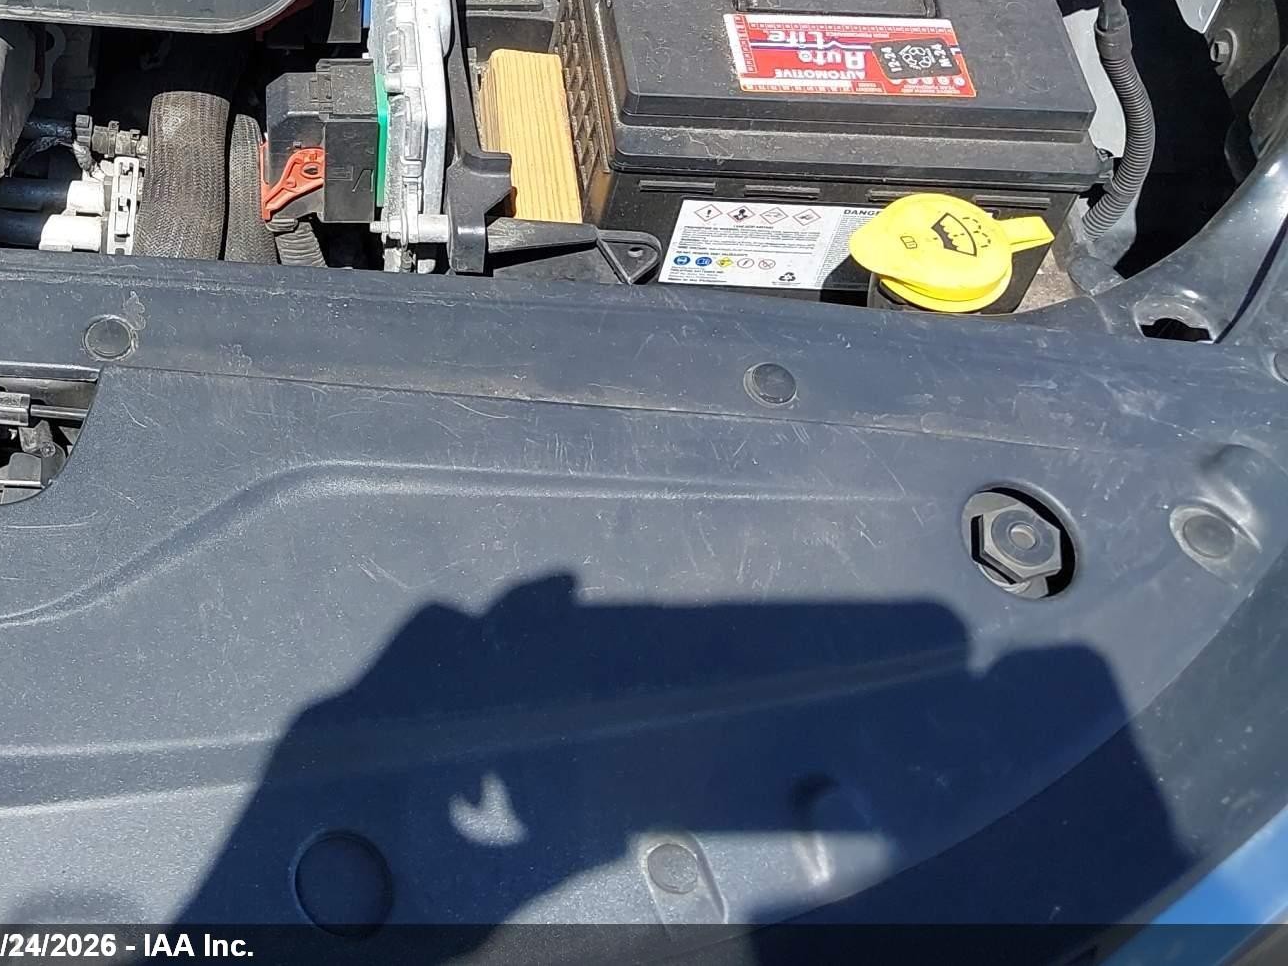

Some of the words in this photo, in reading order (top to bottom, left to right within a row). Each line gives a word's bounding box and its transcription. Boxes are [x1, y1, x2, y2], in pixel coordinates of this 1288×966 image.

[767, 29, 825, 49] Life
[797, 49, 866, 70] Auto
[774, 68, 866, 80] AUTOMOTIVE
